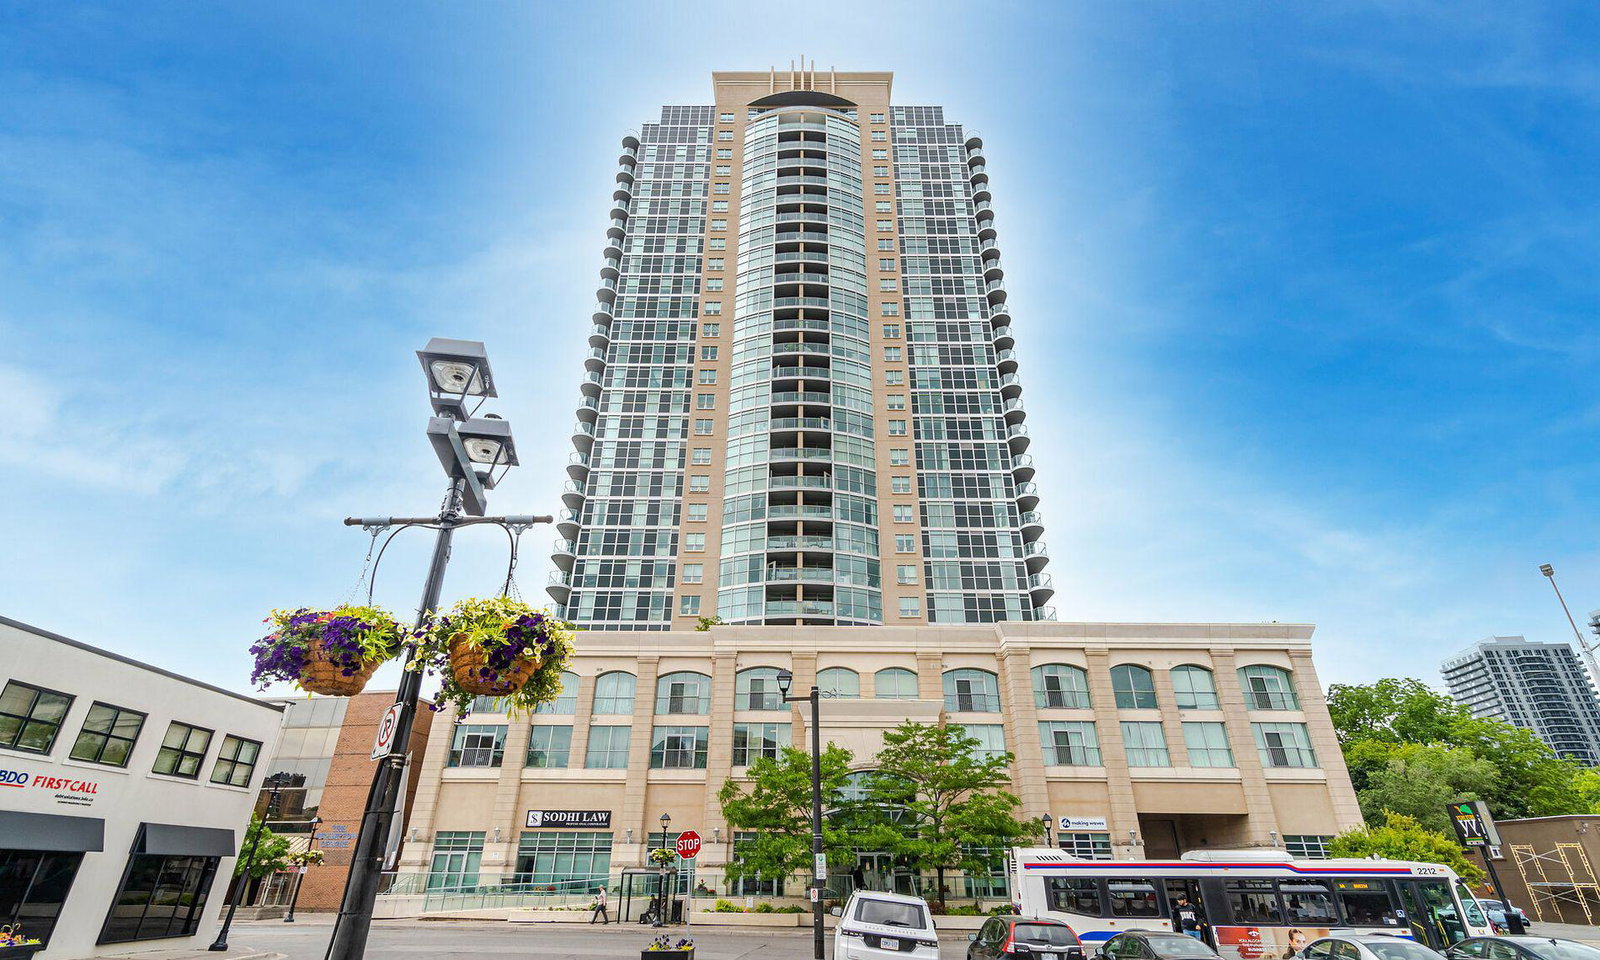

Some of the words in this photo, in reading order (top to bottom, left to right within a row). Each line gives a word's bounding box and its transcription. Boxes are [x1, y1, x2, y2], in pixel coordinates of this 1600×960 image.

[0, 769, 29, 784] BDO
[543, 812, 580, 822] SODHI
[582, 812, 609, 822] LAW
[678, 839, 700, 851] STOP
[1416, 867, 1438, 875] 2212
